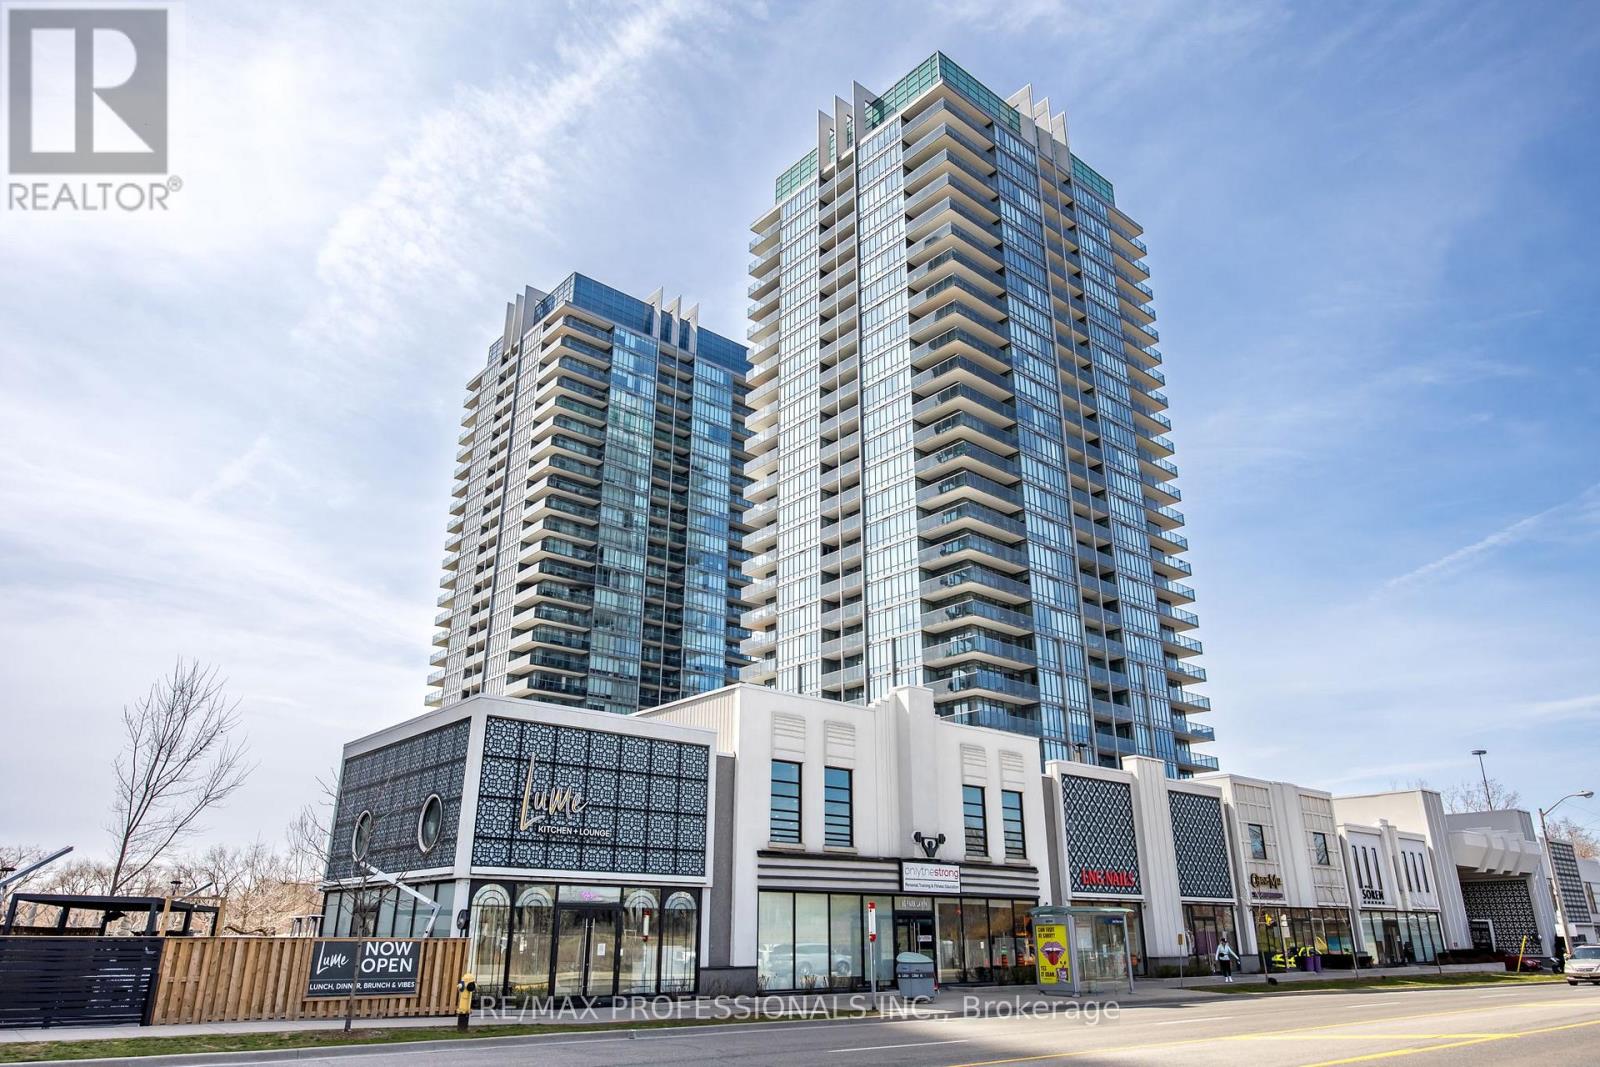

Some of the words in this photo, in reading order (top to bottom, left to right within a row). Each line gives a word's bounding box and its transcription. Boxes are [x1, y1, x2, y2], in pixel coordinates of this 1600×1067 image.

[519, 752, 590, 831] Lume
[538, 825, 573, 835] KITCHEN
[579, 828, 611, 837] LOUNGE
[316, 941, 350, 975] Lume
[365, 941, 413, 956] NOW
[361, 958, 413, 973] OPEN
